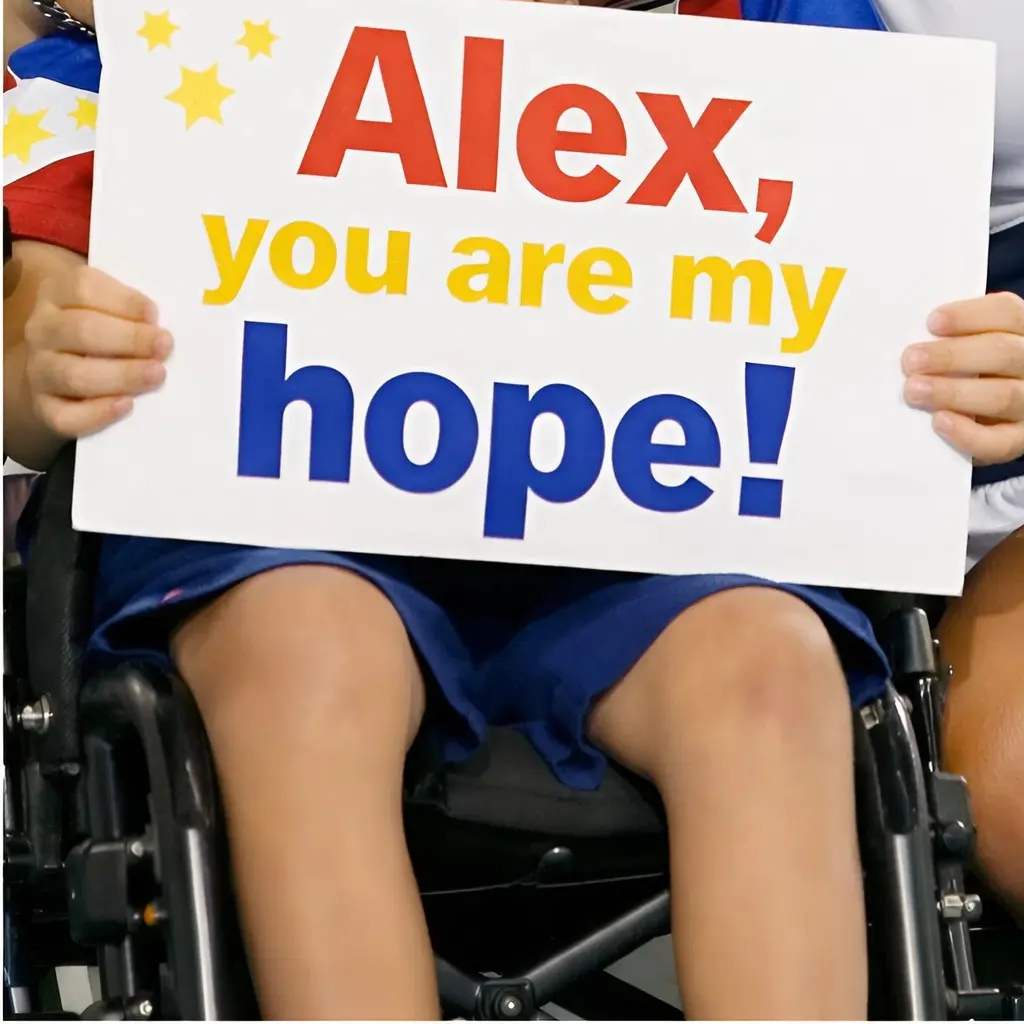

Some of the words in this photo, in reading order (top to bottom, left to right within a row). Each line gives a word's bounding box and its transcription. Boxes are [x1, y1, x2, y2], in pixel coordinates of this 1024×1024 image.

[297, 25, 794, 245] Alex,
[201, 213, 412, 307] you
[445, 235, 634, 316] are
[669, 254, 848, 355] my
[237, 320, 797, 540] hope!
